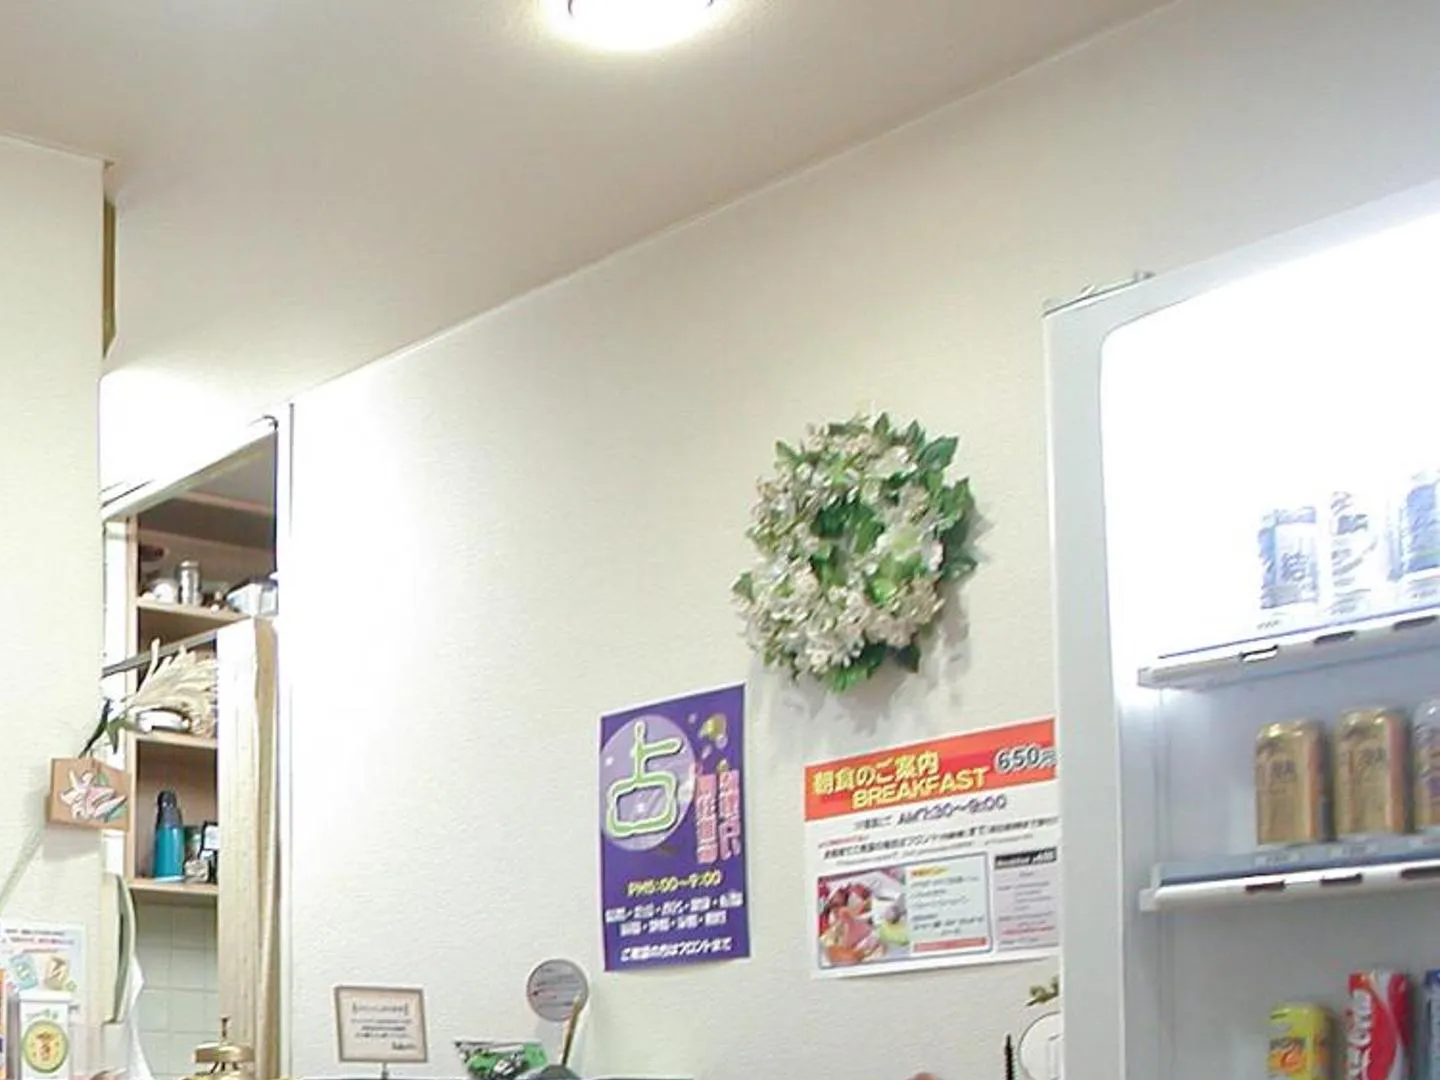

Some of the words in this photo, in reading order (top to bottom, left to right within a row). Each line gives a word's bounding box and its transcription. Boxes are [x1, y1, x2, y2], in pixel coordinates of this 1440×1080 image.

[812, 750, 940, 796] 朝食のご案内
[852, 766, 990, 810] BREAKFAST
